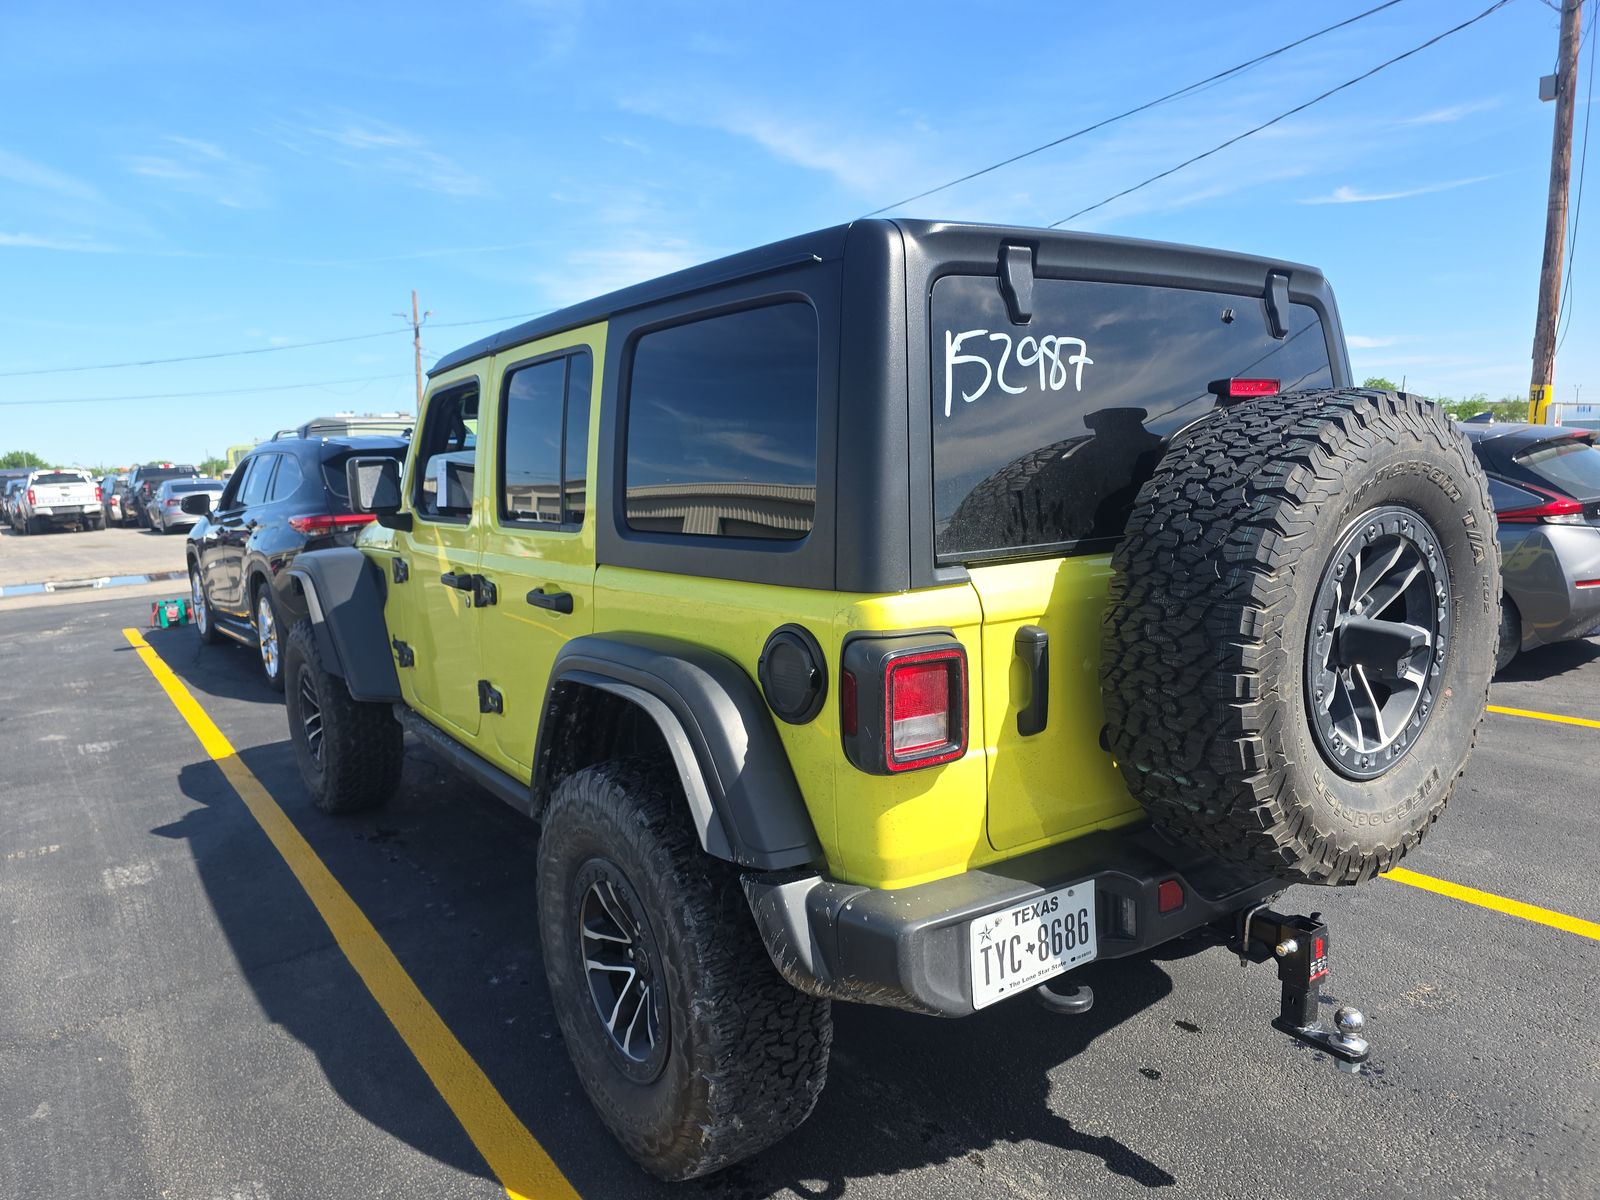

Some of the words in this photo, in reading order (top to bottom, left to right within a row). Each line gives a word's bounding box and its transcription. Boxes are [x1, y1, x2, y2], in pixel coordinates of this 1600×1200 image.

[945, 330, 1094, 417] 152987
[1462, 507, 1486, 567] T/A
[1313, 764, 1441, 830] BFGoodrich
[1012, 896, 1059, 927] TEXAS
[980, 934, 1022, 986] TYC
[1037, 908, 1089, 962] 8686
[1009, 979, 1021, 989] The
[1022, 973, 1037, 984] Lone
[1038, 967, 1050, 977] Star
[1051, 960, 1067, 971] State
